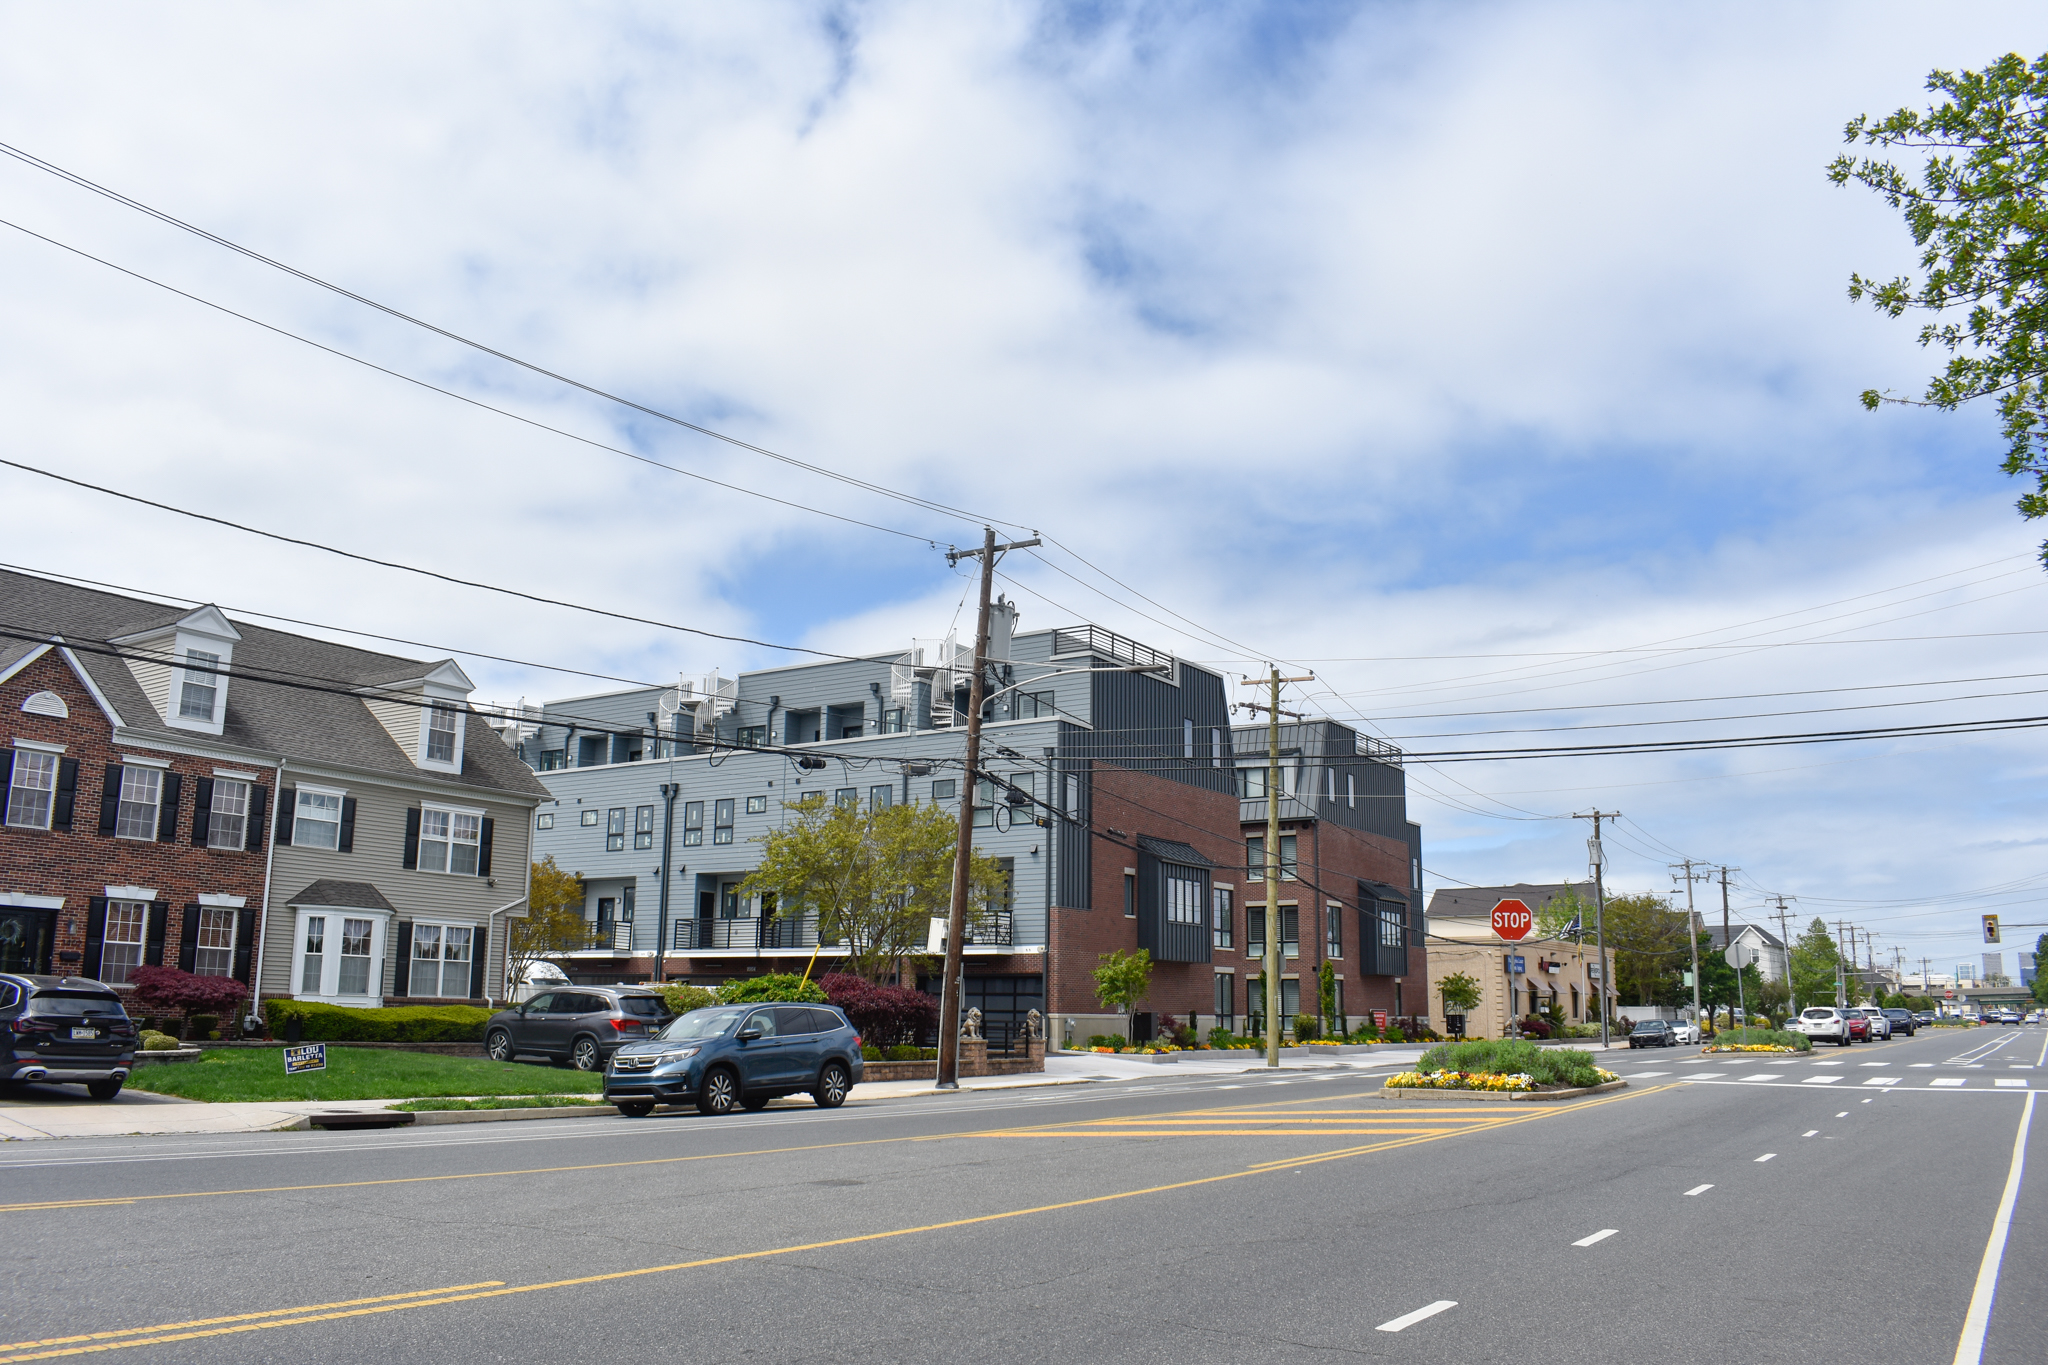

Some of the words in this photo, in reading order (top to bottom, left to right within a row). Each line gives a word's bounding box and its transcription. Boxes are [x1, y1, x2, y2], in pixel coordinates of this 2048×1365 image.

[1494, 912, 1529, 928] STOP
[301, 1046, 319, 1055] LOU
[287, 1053, 323, 1062] BARLETTA
